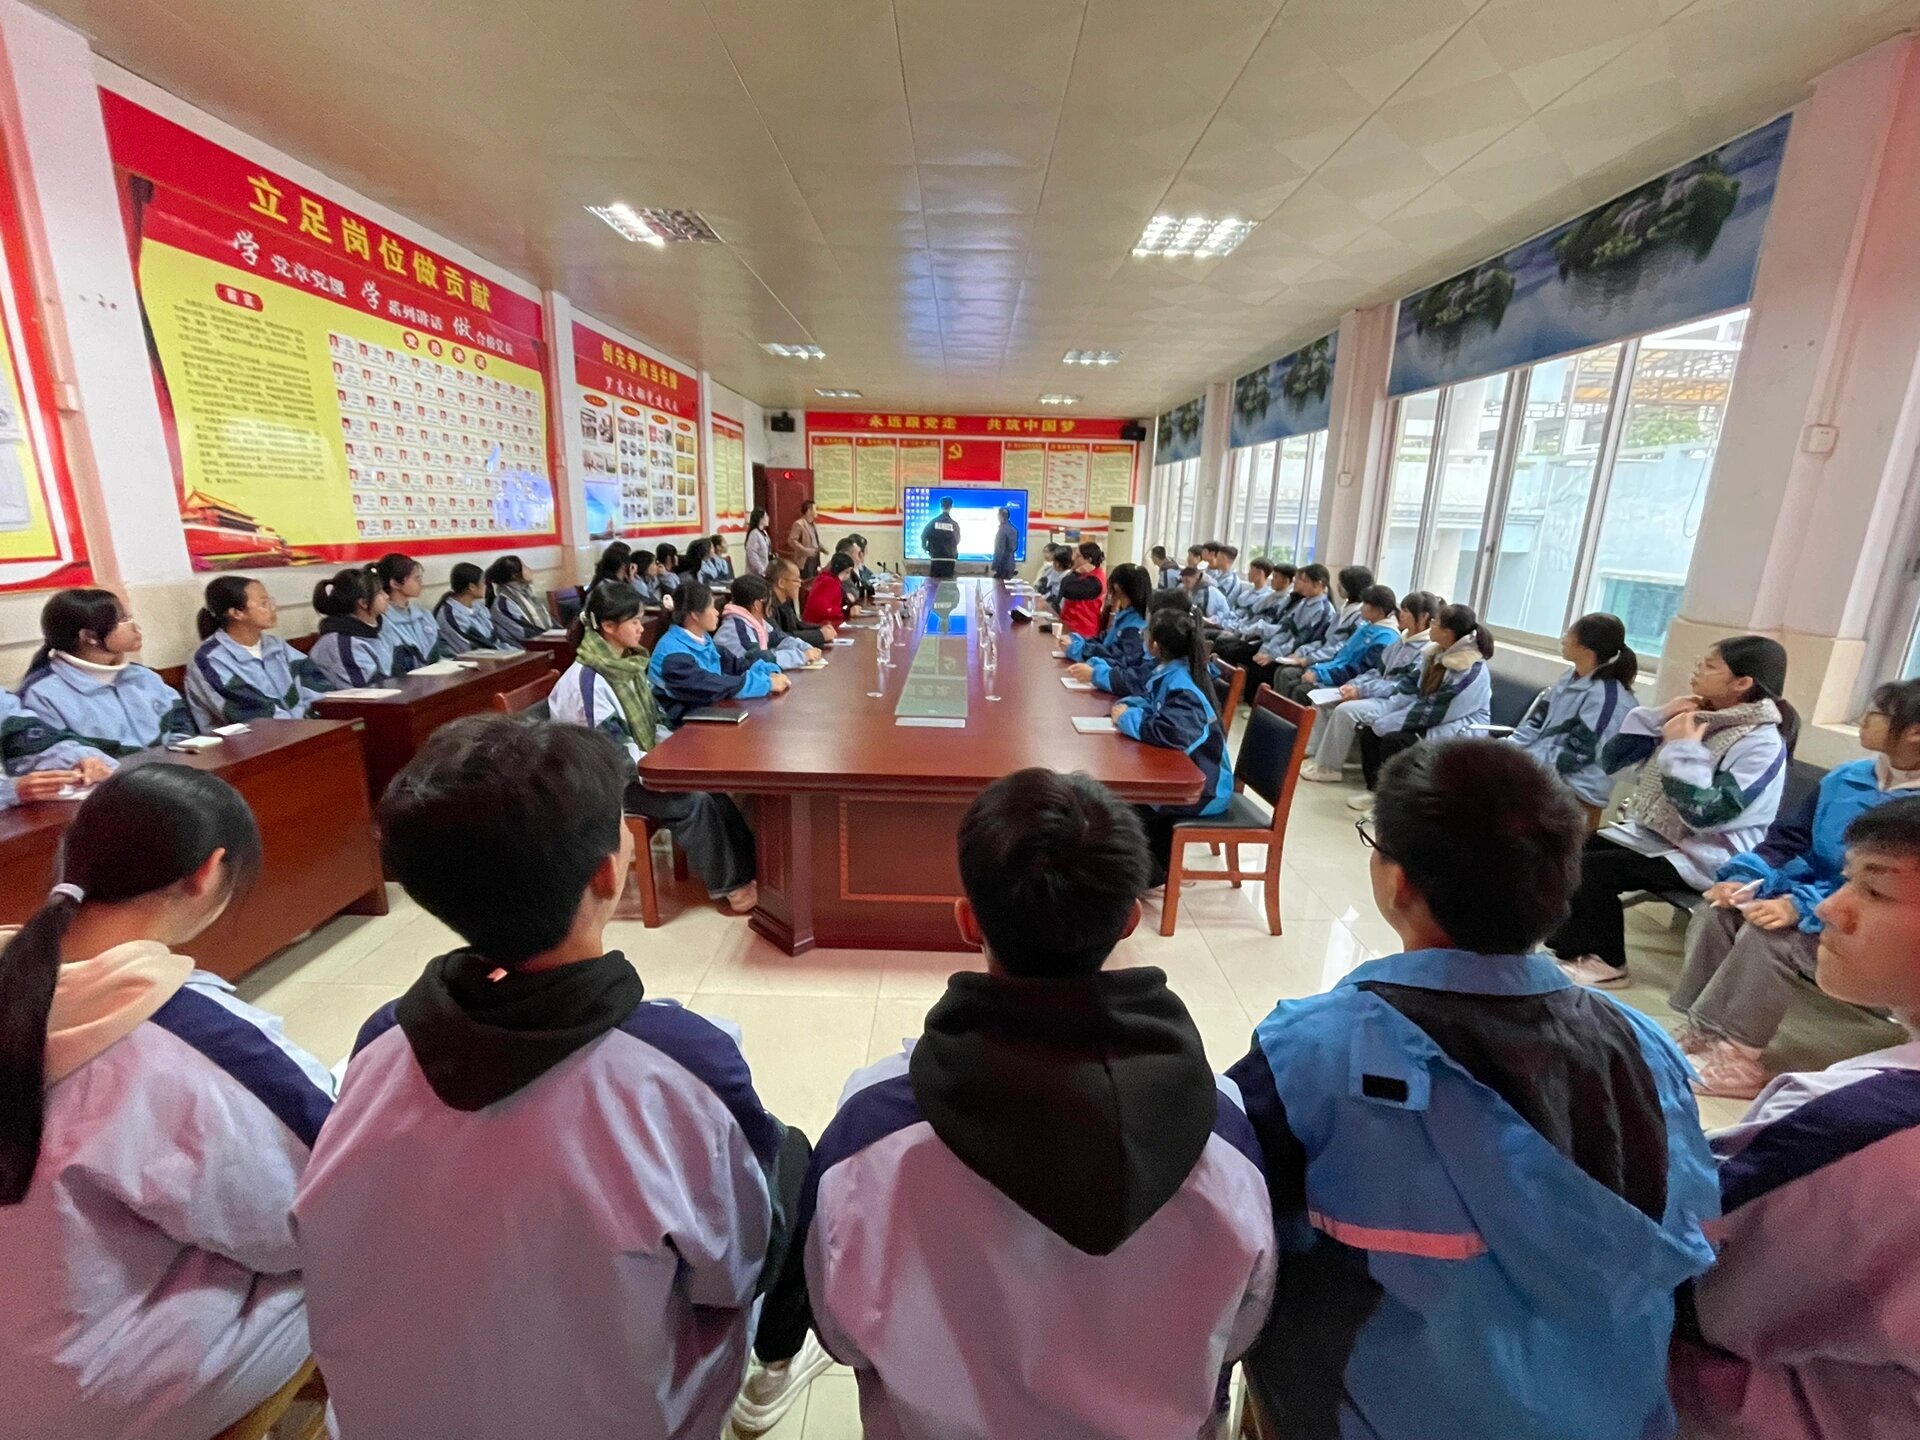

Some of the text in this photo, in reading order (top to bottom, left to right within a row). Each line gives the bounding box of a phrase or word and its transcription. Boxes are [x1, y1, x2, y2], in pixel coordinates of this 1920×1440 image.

[232, 229, 260, 266] 学
[361, 279, 381, 311] 学
[452, 315, 475, 343] 做
[247, 175, 491, 312] 立足岗位做贡献
[869, 414, 1076, 432] 永远跟党走 共筑中国梦
